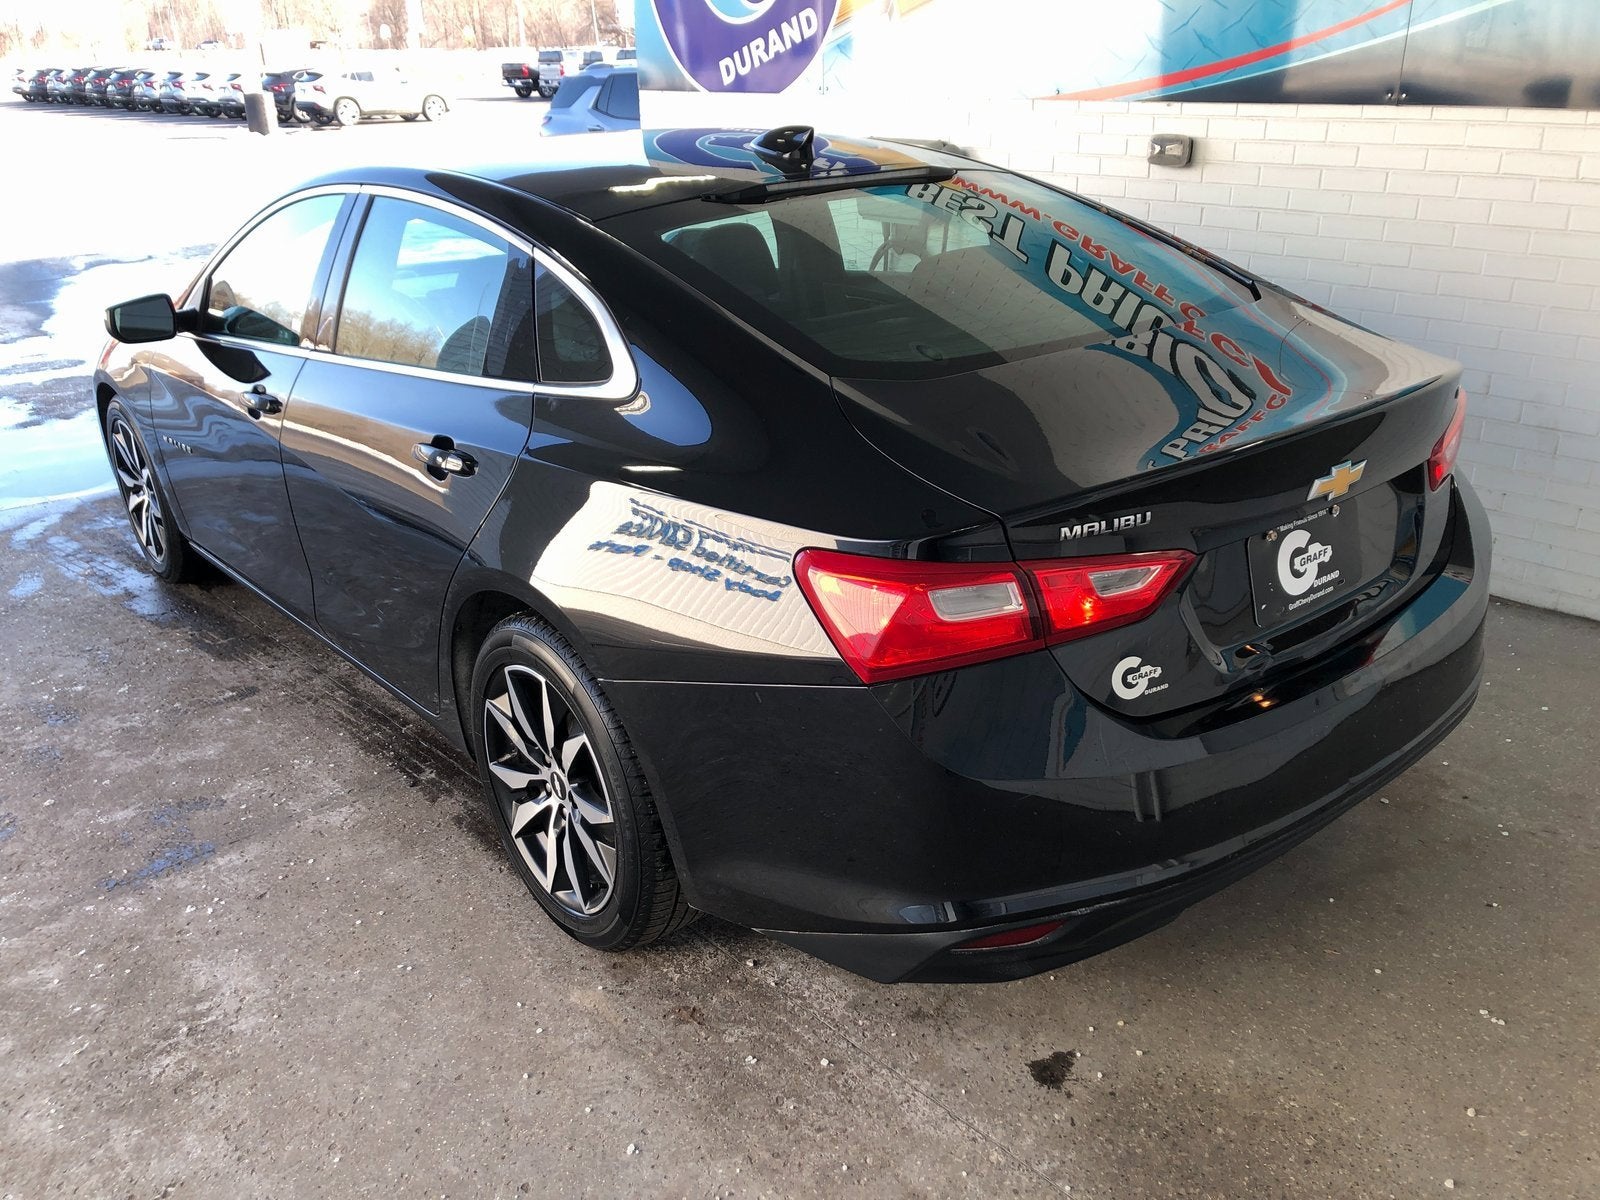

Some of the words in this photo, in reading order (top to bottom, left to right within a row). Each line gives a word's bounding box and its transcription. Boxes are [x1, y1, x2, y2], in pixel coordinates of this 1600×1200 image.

[718, 7, 818, 86] DURAND
[1059, 511, 1152, 541] MALIBU
[1300, 548, 1328, 567] GRAFF
[1313, 570, 1340, 588] DURAND
[1131, 667, 1159, 682] GRAFF
[1144, 683, 1169, 696] DURAND
